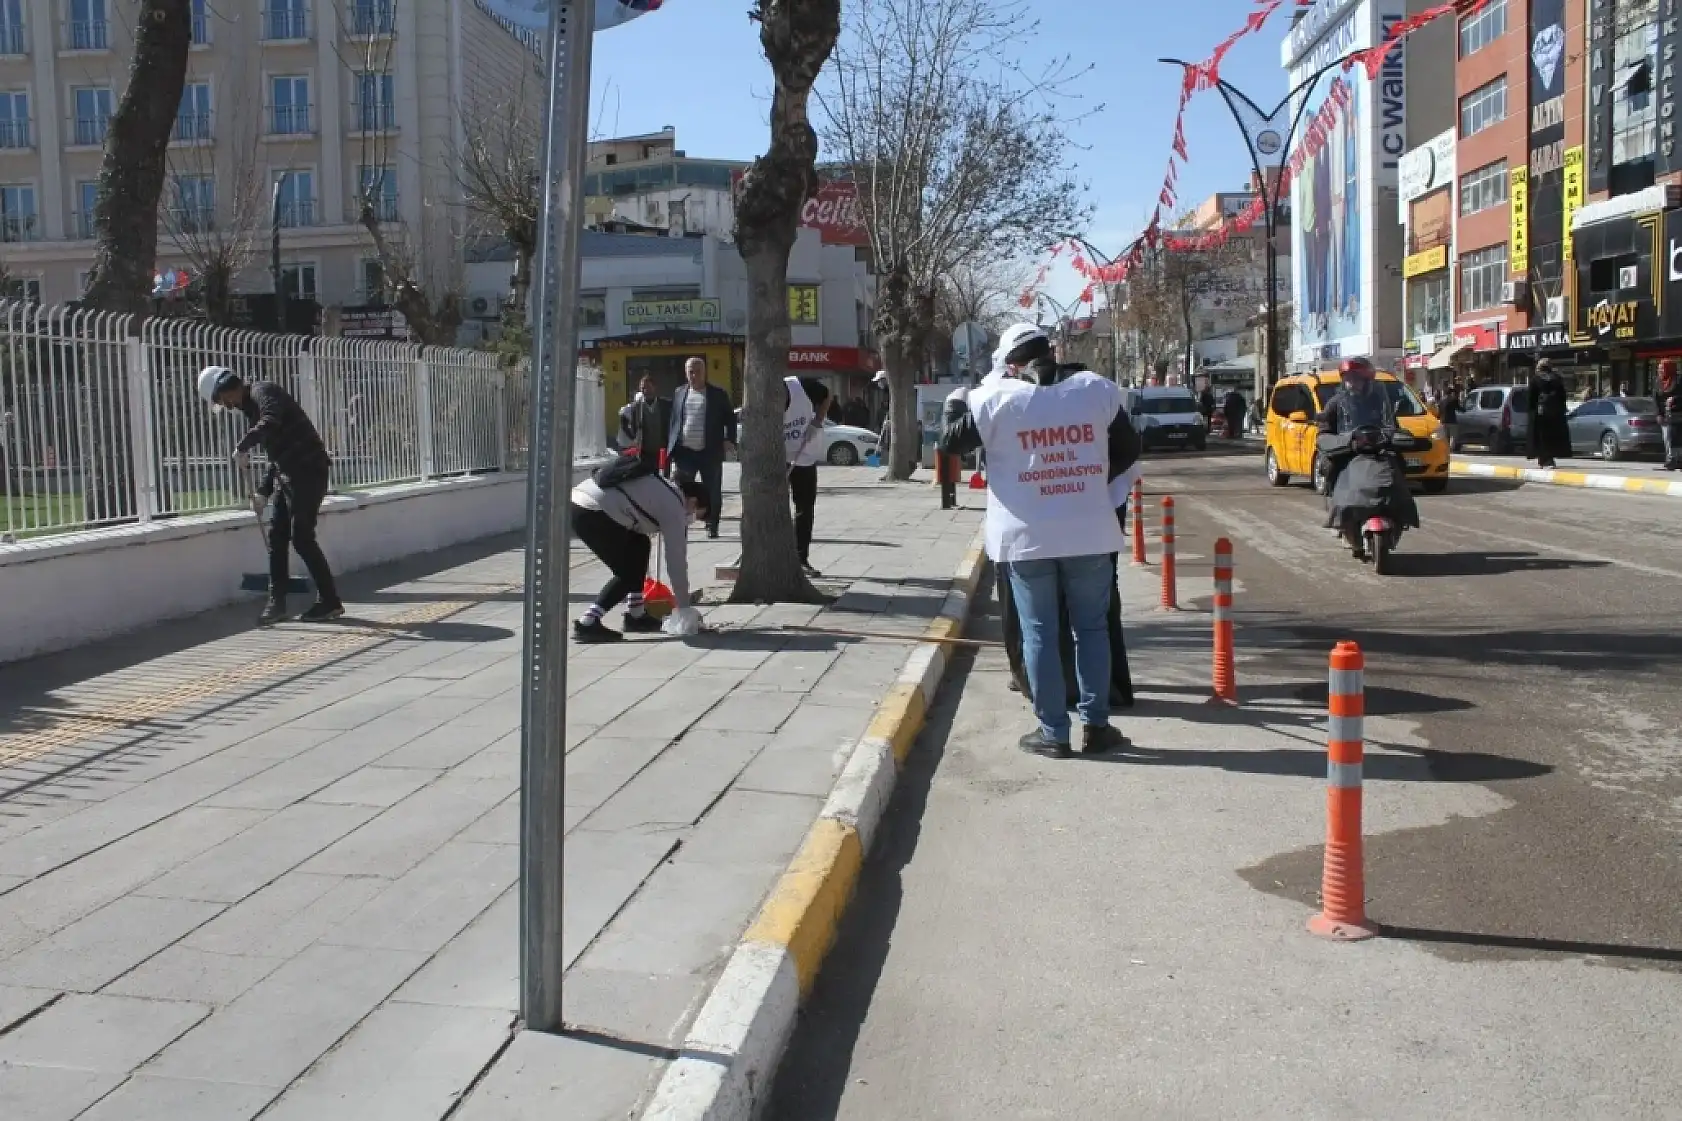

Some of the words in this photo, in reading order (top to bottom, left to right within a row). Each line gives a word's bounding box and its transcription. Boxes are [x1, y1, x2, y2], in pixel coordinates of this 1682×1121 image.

[1587, 302, 1639, 328] HAYAT
[1615, 326, 1634, 338] GSM
[1511, 334, 1537, 349] ALTIN
[789, 351, 830, 362] BANK
[1017, 423, 1094, 450] TMMOB
[1041, 452, 1065, 463] VAN
[1018, 464, 1103, 483] KOORDİNASYON
[1040, 482, 1086, 496] KURULU
